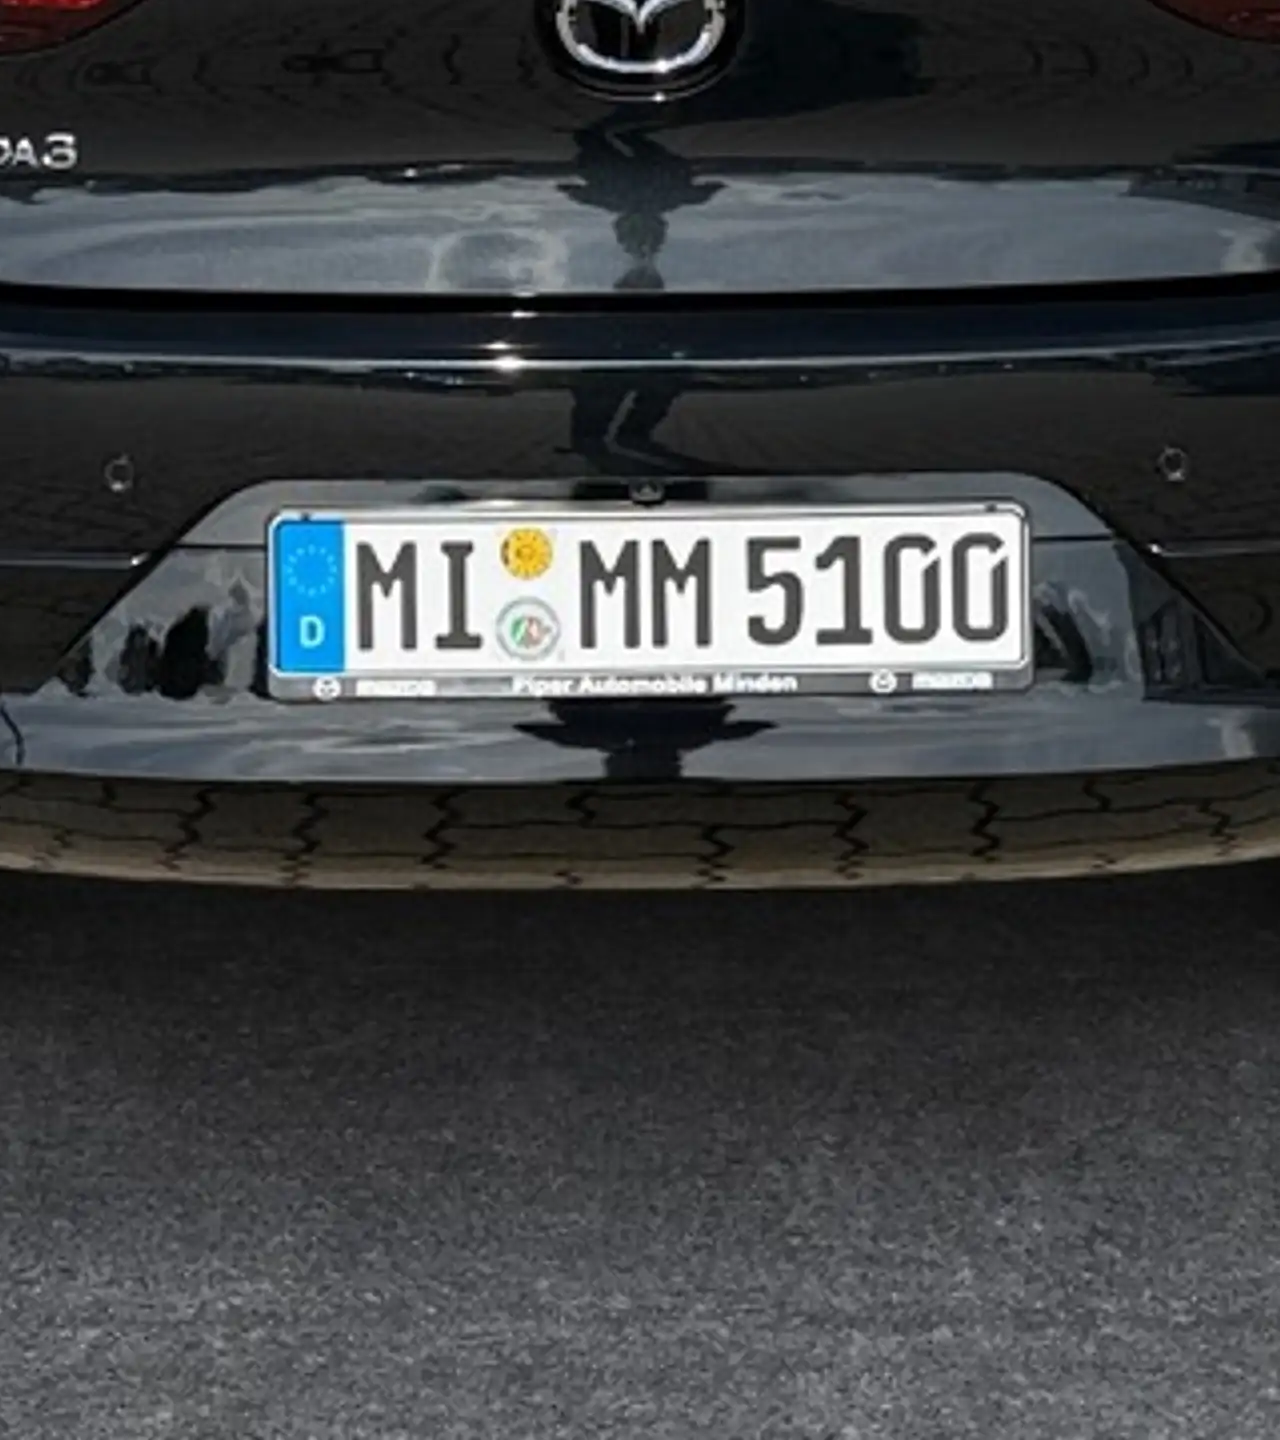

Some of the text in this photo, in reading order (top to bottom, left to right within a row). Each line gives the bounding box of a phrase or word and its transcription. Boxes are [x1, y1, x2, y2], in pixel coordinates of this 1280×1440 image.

[356, 533, 1009, 651] MI MM 5100
[298, 615, 326, 648] D
[578, 673, 708, 694] Automobile
[712, 672, 798, 693] Minden
